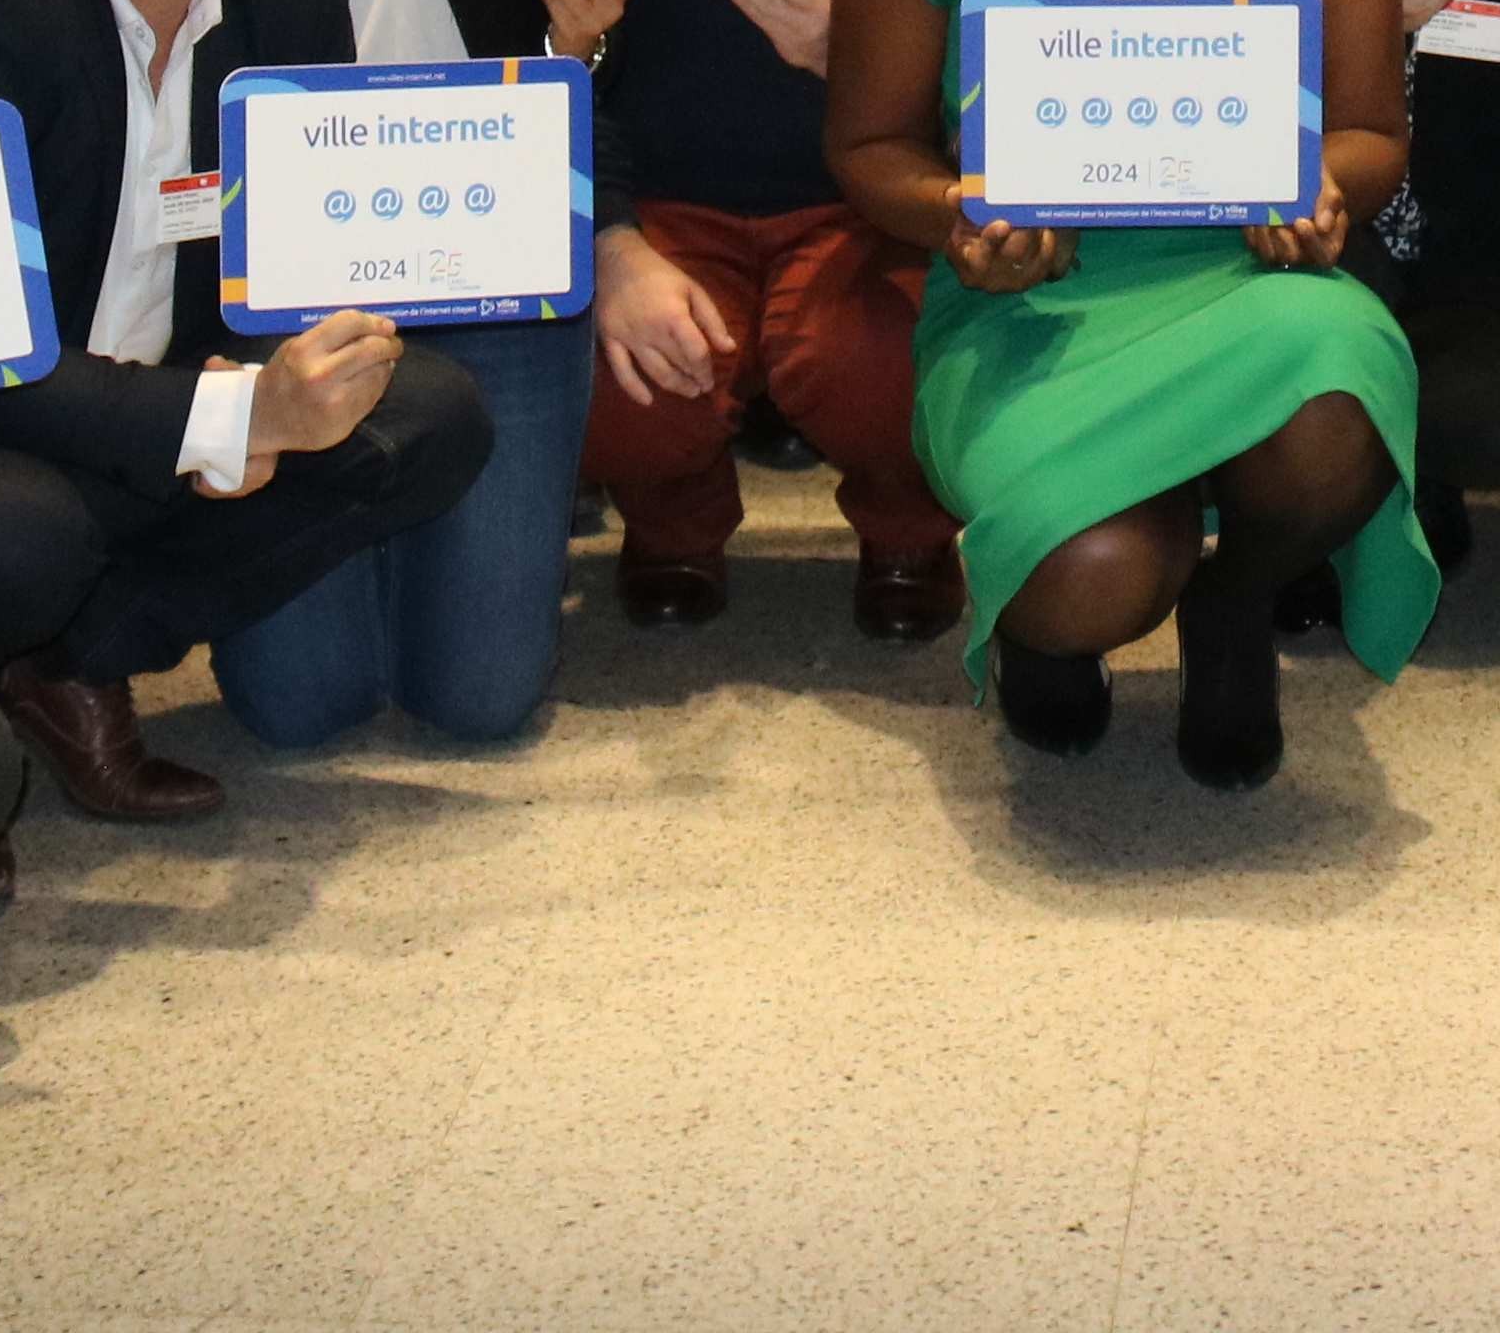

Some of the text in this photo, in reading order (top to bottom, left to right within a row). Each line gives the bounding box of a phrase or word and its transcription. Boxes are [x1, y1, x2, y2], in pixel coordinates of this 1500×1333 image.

[1038, 28, 1247, 59] ville internet
[302, 112, 516, 149] ville internet
[1082, 162, 1139, 184] 2024
[349, 258, 407, 283] 2024
